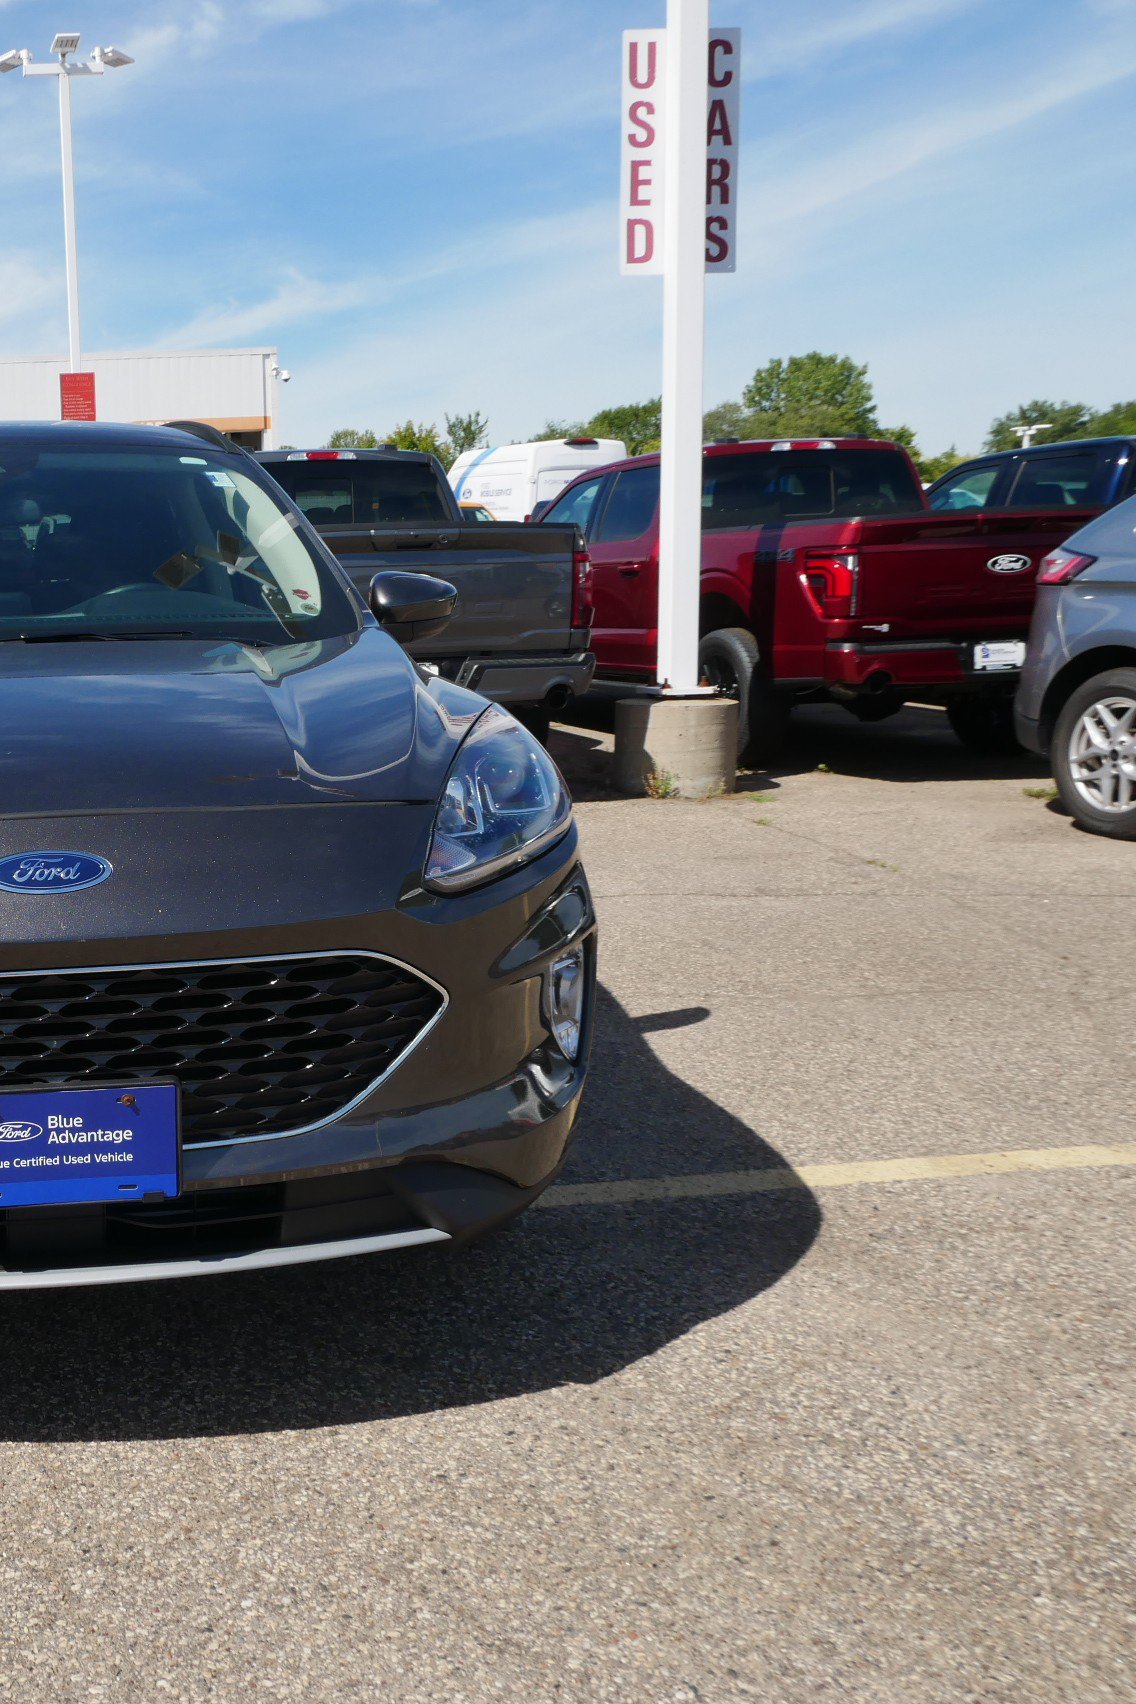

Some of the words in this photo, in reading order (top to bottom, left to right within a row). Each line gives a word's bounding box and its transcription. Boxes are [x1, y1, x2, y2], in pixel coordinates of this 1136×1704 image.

[626, 41, 657, 264] USED
[705, 38, 733, 263] CARS
[14, 857, 81, 882] Ford
[48, 1114, 83, 1129] Blue
[48, 1127, 133, 1144] Advantage
[13, 1155, 60, 1168] Certified
[63, 1154, 91, 1165] Used
[94, 1152, 133, 1163] Vehicle
